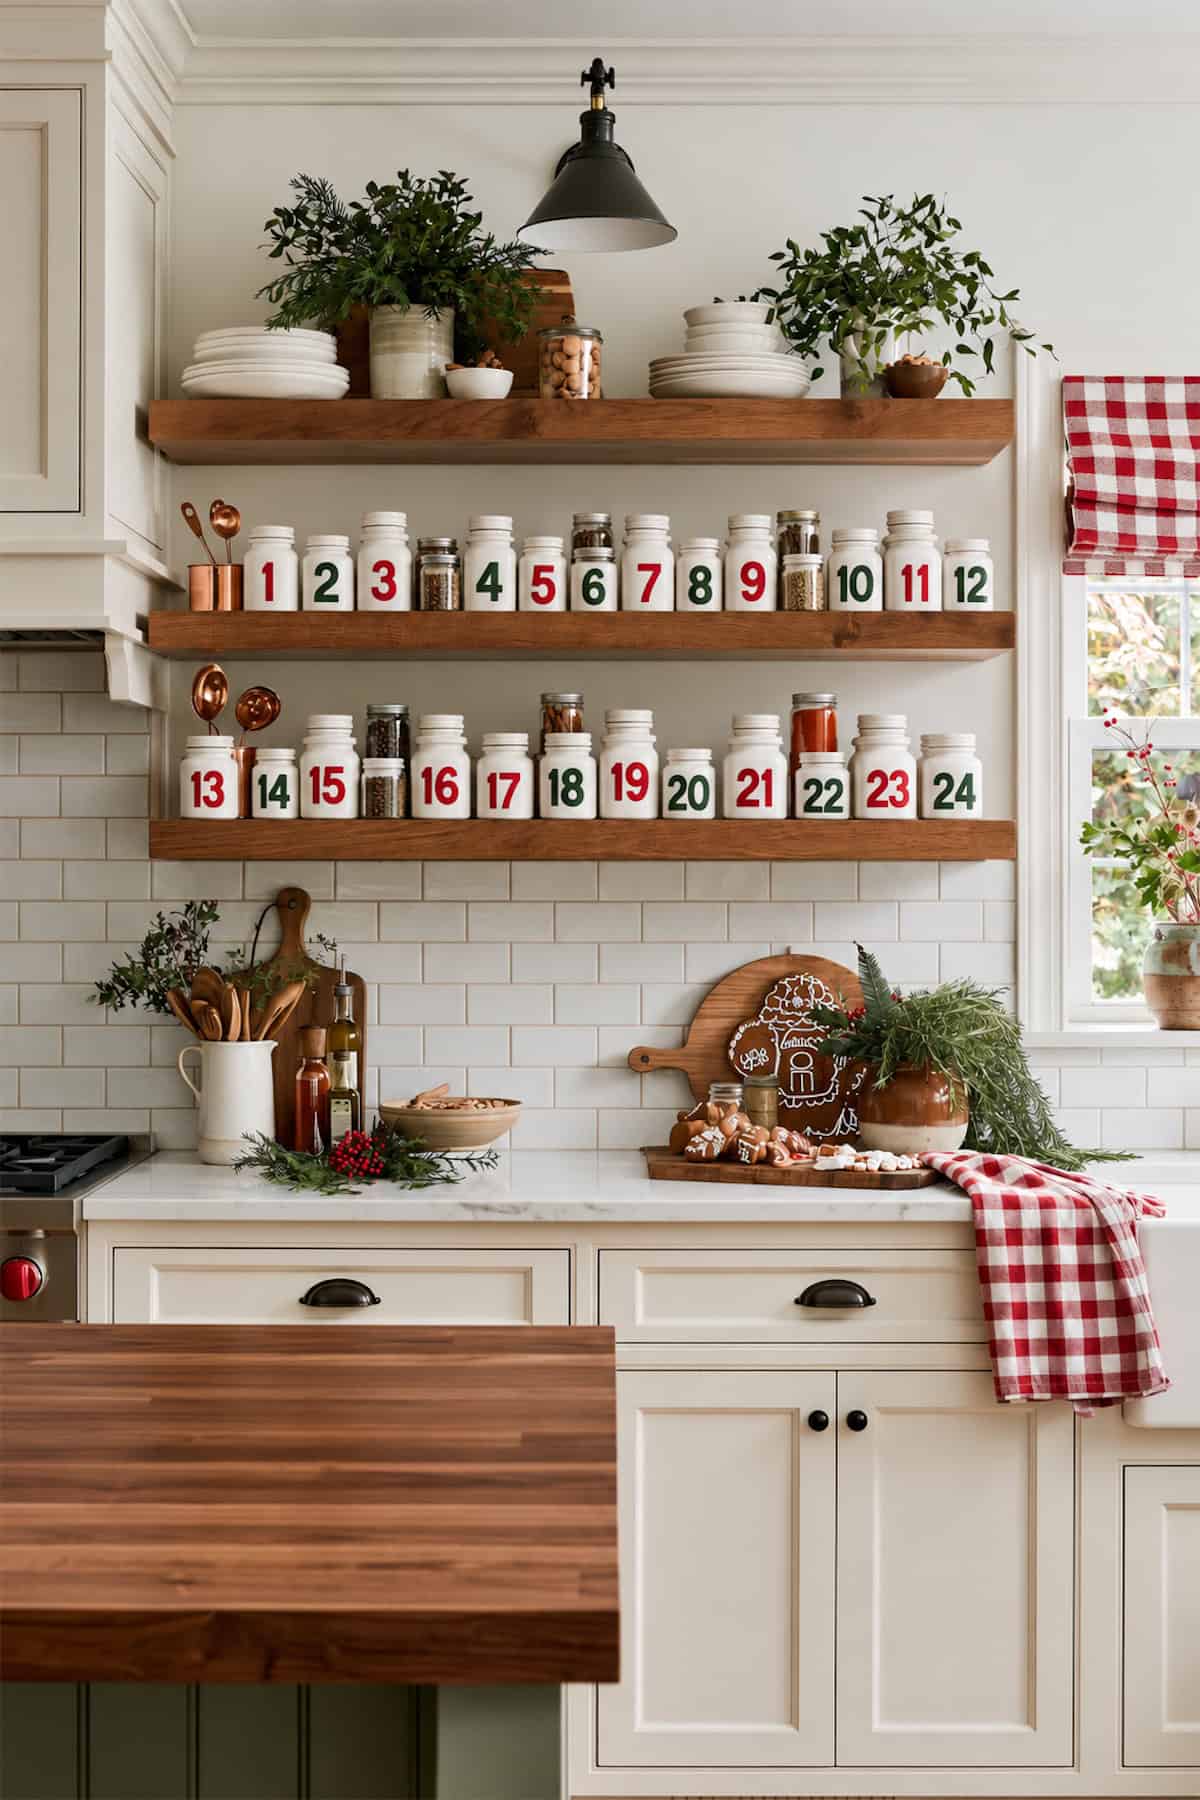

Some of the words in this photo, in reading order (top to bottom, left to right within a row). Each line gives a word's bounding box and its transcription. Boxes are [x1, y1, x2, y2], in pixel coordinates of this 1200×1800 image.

[261, 561, 274, 602] 1
[313, 561, 340, 603] 2
[370, 559, 397, 602] 3
[475, 561, 503, 602] 4
[531, 564, 556, 605] 5
[582, 567, 606, 606] 6
[637, 563, 662, 603] 7
[687, 565, 713, 606] 8
[739, 560, 766, 602] 9
[837, 564, 874, 603] 10
[901, 564, 929, 603] 11
[954, 566, 987, 603] 12
[192, 770, 225, 809] 13
[257, 773, 290, 809] 14
[310, 765, 346, 805] 15
[421, 766, 459, 806] 16
[487, 772, 521, 810] 17
[550, 767, 585, 808] 18
[612, 761, 649, 802] 19
[667, 774, 710, 812] 20
[735, 767, 773, 808] 21
[804, 777, 844, 814] 22
[866, 769, 910, 809] 23
[932, 772, 976, 810] 24
